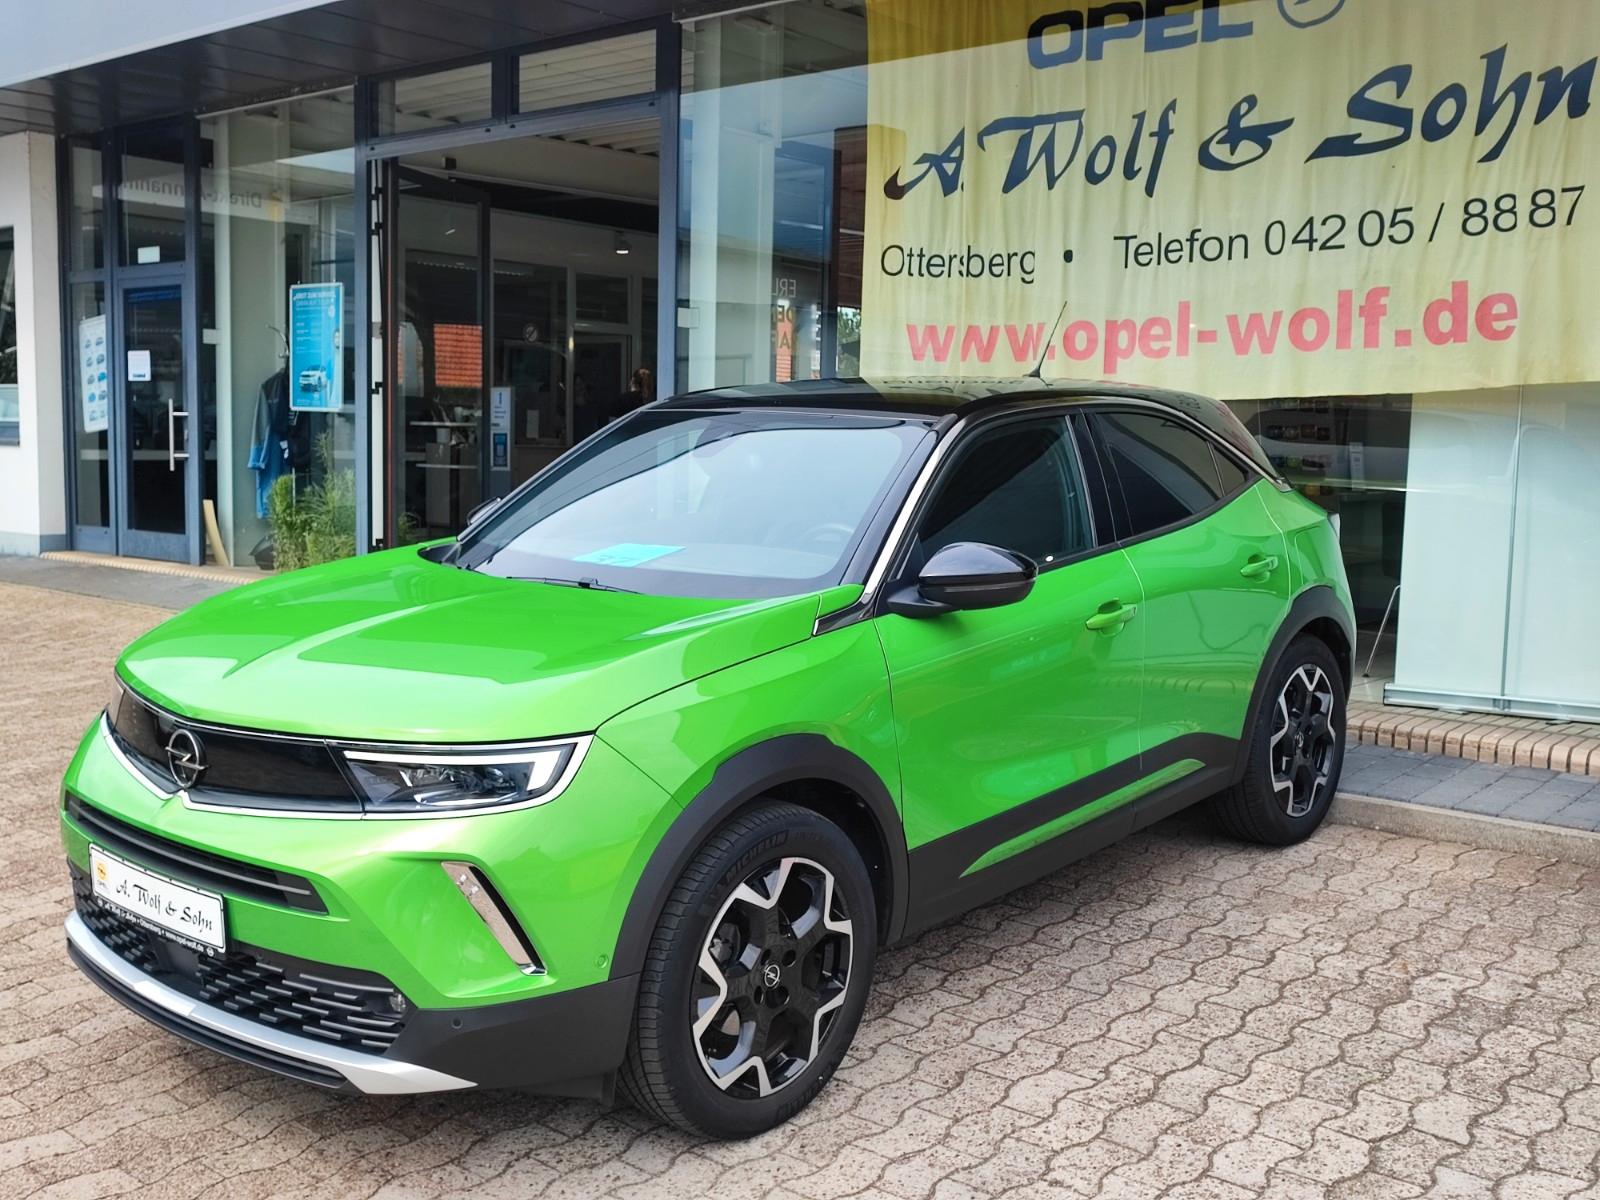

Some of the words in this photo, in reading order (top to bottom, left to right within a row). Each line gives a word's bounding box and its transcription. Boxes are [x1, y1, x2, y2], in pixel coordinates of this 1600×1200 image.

[1027, 0, 1254, 69] OPEL
[977, 98, 1177, 198] Wolf
[1198, 94, 1295, 171] &
[1304, 42, 1598, 164] Sohn
[1113, 228, 1249, 269] Telefon
[906, 280, 1519, 374] www.opel-wolf.de
[165, 901, 177, 916] &
[180, 907, 212, 932] Sohn
